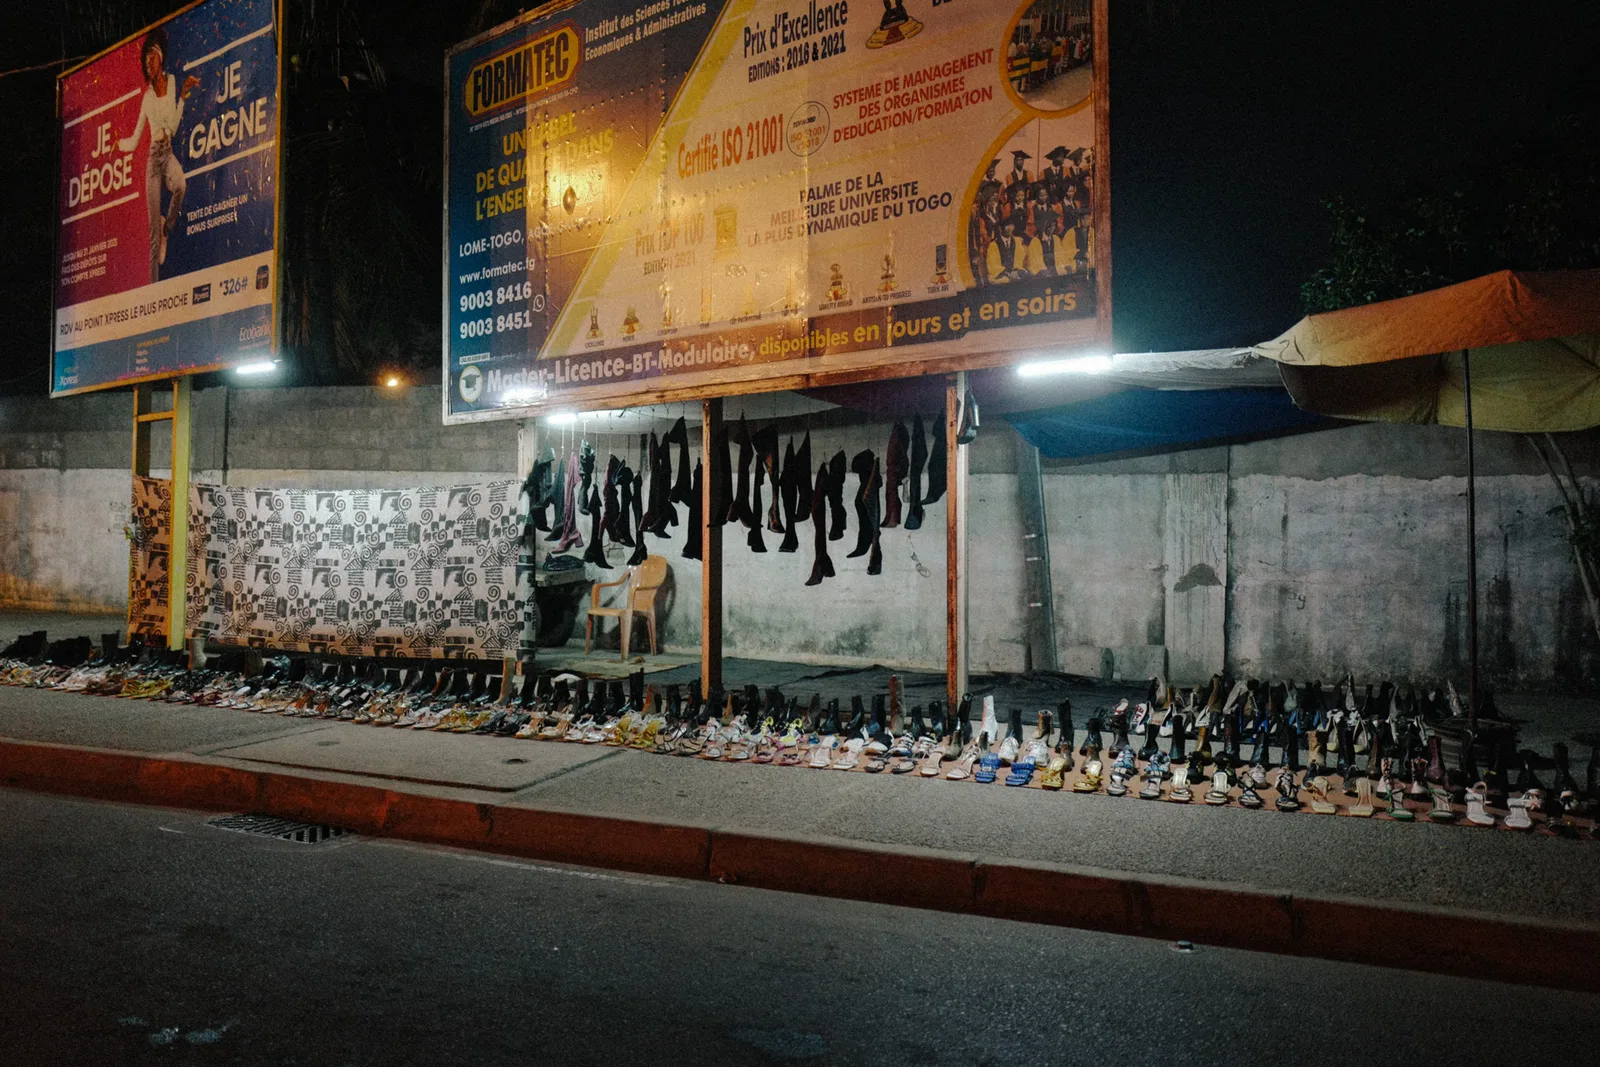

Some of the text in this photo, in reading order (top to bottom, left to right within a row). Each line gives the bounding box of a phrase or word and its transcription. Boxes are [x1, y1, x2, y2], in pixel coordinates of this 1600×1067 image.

[585, 2, 706, 61] Economiques & Administratives
[586, 0, 670, 43] Institut des Sciences
[744, 0, 848, 58] Prix d'Excellence
[473, 32, 568, 112] FORMATEC
[748, 56, 780, 83] EDITIONS
[787, 42, 809, 70] 2016
[812, 42, 818, 61] &
[821, 30, 846, 59] 2021
[216, 60, 242, 104] JE
[834, 82, 881, 109] SYSTEME
[884, 77, 900, 94] DE
[859, 76, 964, 119] DES ORGANISMES
[92, 122, 112, 159] JE
[189, 96, 268, 159] GAGNE
[503, 112, 576, 155] UN LABEL
[678, 114, 783, 179] Certifié ISO 21001
[68, 153, 132, 208] DÉPOSE
[476, 168, 494, 193] DE
[800, 172, 883, 202] PALME DE LA
[840, 181, 918, 212] UNIVERSITE
[186, 212, 234, 235] BONUS SURPRISE
[187, 208, 204, 222] TENTE
[204, 205, 212, 216] DE
[213, 198, 238, 212] GAGNER
[765, 226, 793, 245] PLUS
[797, 208, 878, 237] DYNAMIQUE
[883, 202, 903, 220] DU
[907, 192, 952, 214] TOGO
[460, 230, 524, 257] LOME-TOGO,
[460, 258, 535, 284] www.formatec.tg
[60, 293, 188, 335] RDV AU POINT XPRESS LE PLUS PROCHE
[460, 282, 532, 312] 9003 8416
[460, 310, 532, 339] 9003 8451
[760, 328, 849, 357] disponibles
[854, 324, 879, 342] en
[887, 314, 942, 346] jours
[948, 307, 971, 331] et
[979, 300, 1009, 320] en
[1017, 288, 1076, 317] soirs
